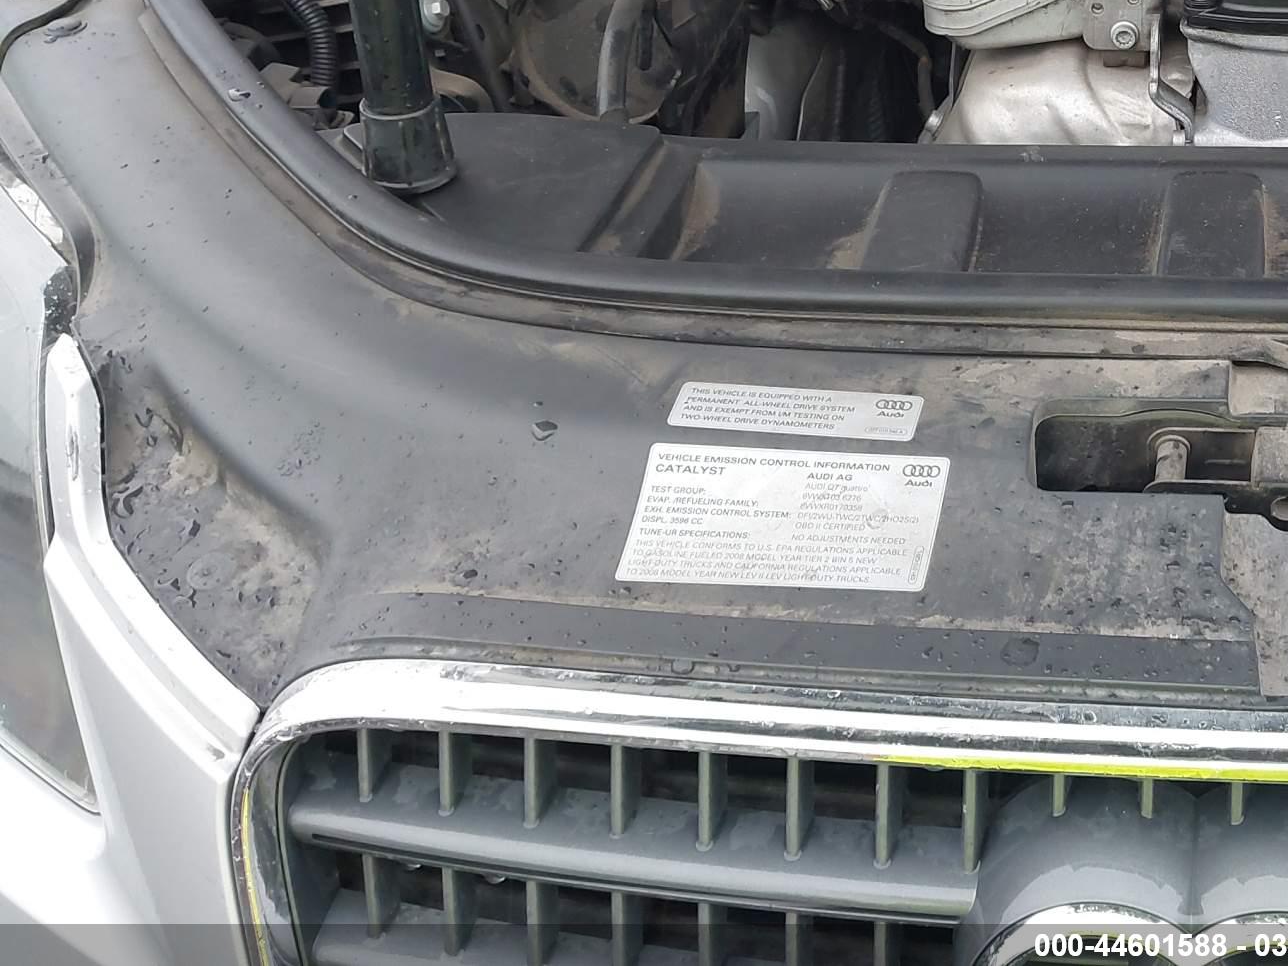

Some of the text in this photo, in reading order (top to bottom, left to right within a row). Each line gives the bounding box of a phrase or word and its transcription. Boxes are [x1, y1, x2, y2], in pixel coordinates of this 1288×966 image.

[692, 387, 832, 403] THIS VEHICLE IS EQUIPPED WITH A
[686, 396, 740, 406] PERMANENT
[792, 403, 818, 411] DRIVE
[820, 404, 856, 413] SYSTEM
[682, 404, 702, 412] AND
[714, 406, 748, 415] EXEMPT
[750, 409, 776, 417] FROM
[794, 411, 830, 420] TESTING
[876, 410, 904, 418] Audi
[734, 416, 759, 424] DRIVE
[760, 418, 834, 430] DYNAMOMETERS
[658, 453, 890, 472] VEHICLE EMISSION CONTROL INFORMATION
[656, 464, 726, 474] CATALYST
[806, 472, 852, 482] AUDI AG
[904, 479, 932, 488] Audi
[650, 485, 672, 493] TEST
[666, 506, 708, 515] EMISSION
[710, 508, 750, 517] CONTROL
[806, 534, 870, 543] ADJUSTMENTS
[870, 536, 906, 544] NEEDED
